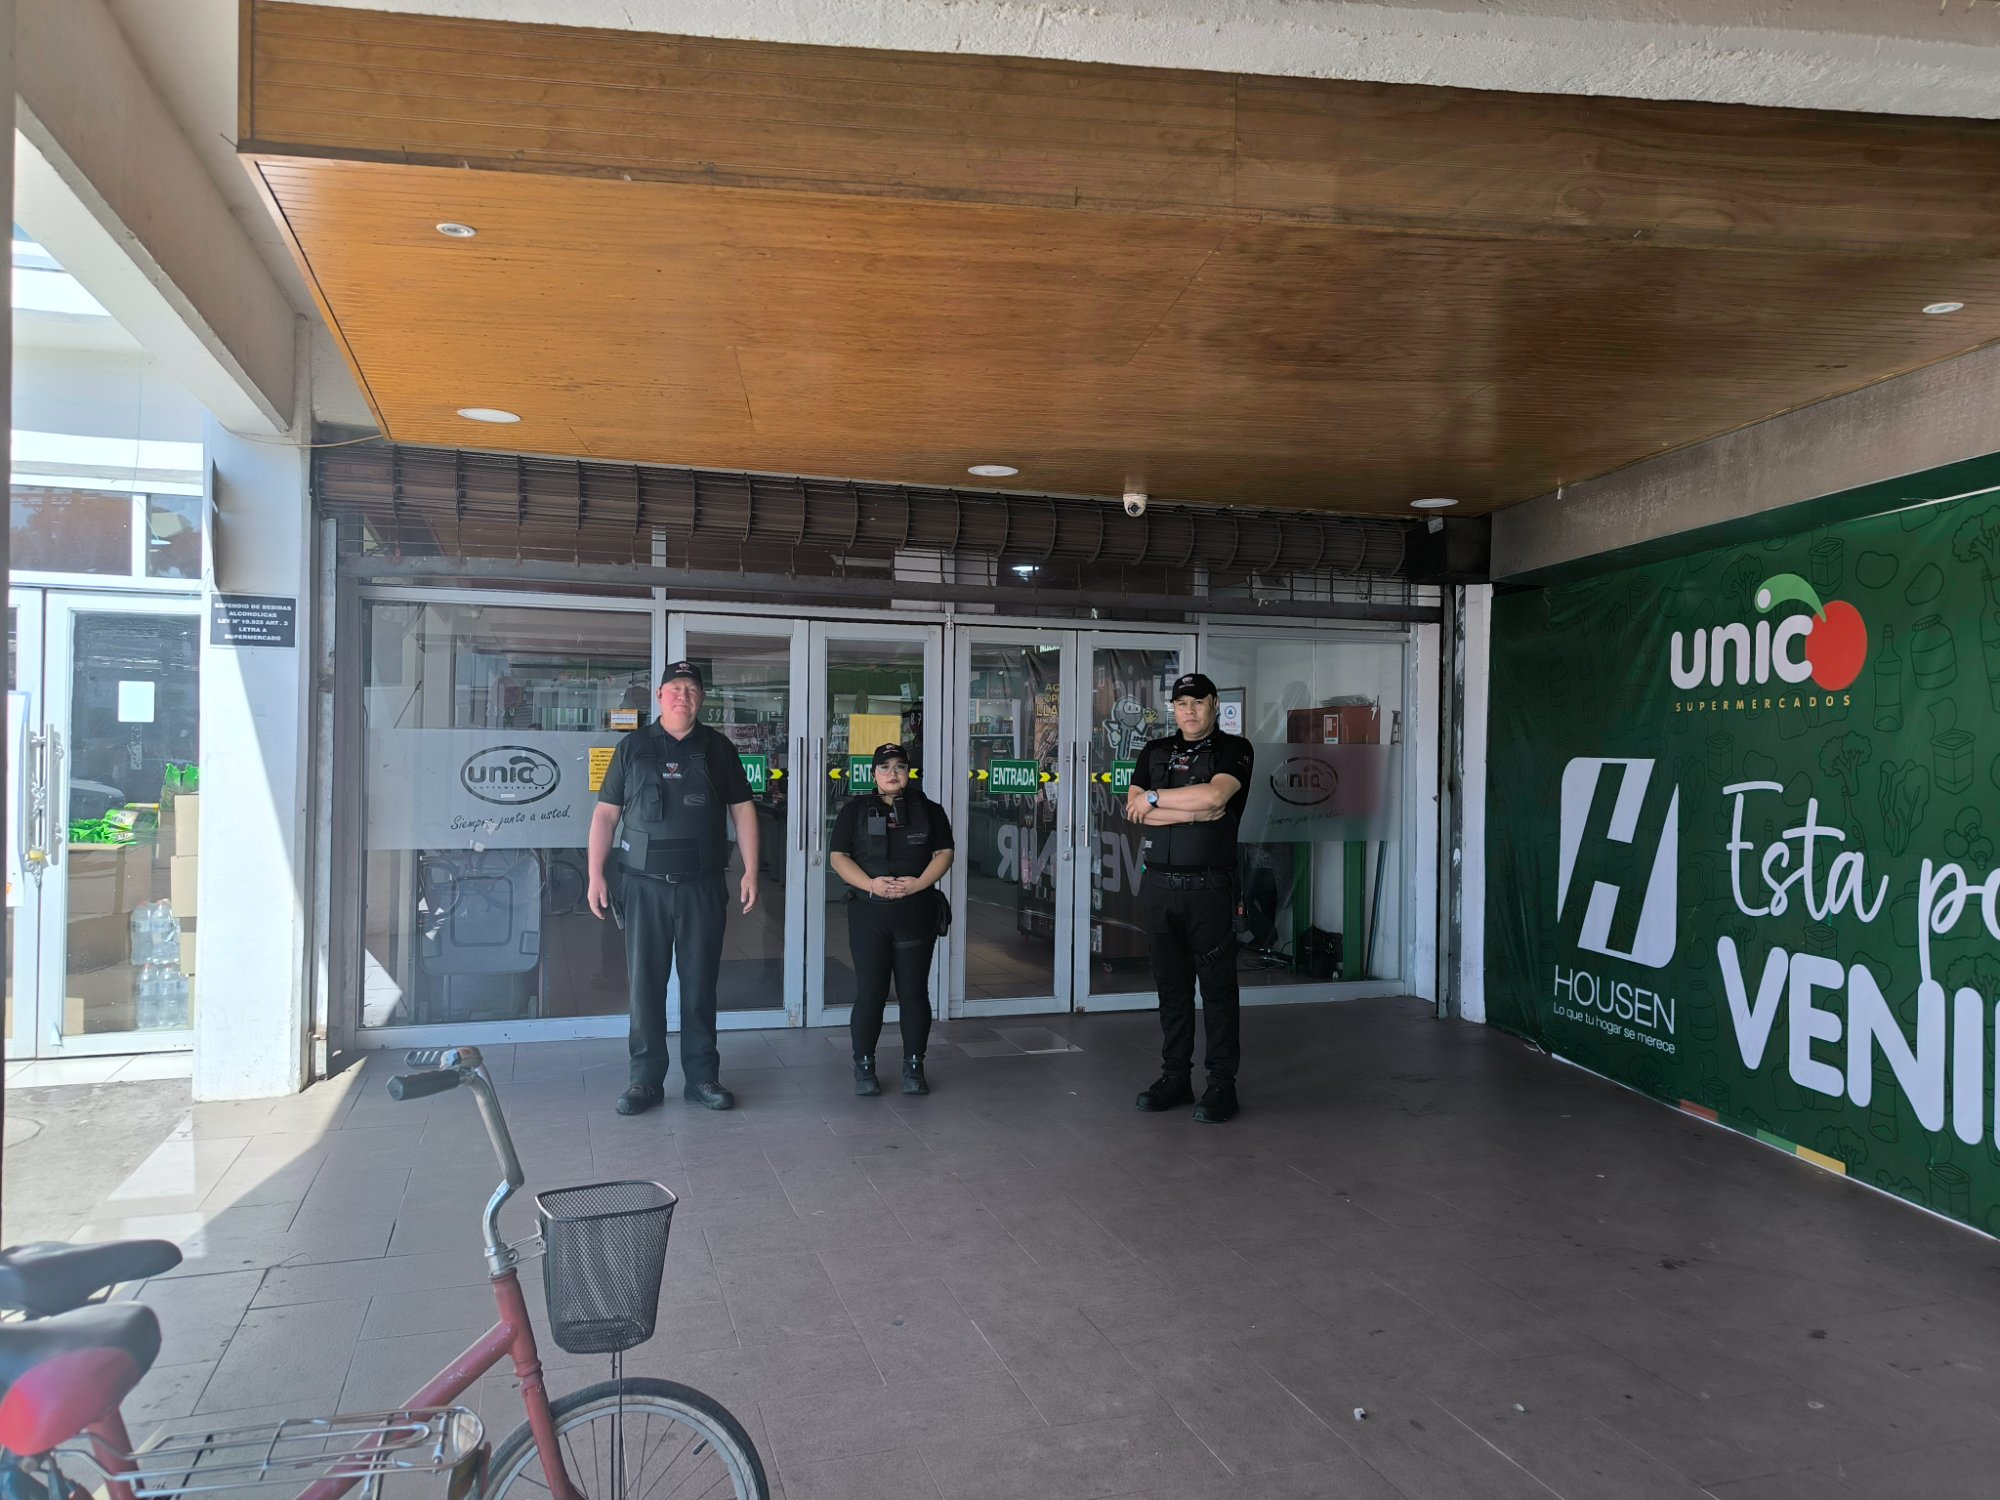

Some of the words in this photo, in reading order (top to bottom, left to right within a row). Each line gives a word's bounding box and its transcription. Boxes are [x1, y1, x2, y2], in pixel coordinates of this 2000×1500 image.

[1675, 695, 1851, 712] SUPERMERCADOS
[992, 767, 1036, 787] ENTRADA
[495, 812, 526, 831] junto
[529, 812, 536, 821] a
[1722, 780, 1889, 923] Esta
[1554, 965, 1675, 1035] HOUSEN
[1553, 1002, 1565, 1016] Lo
[1566, 1009, 1583, 1021] que
[1585, 1012, 1595, 1025] tu
[1596, 1015, 1622, 1035] hogar
[1623, 1027, 1636, 1040] se
[1637, 1032, 1676, 1054] merece
[1717, 935, 2000, 1153] VENI
